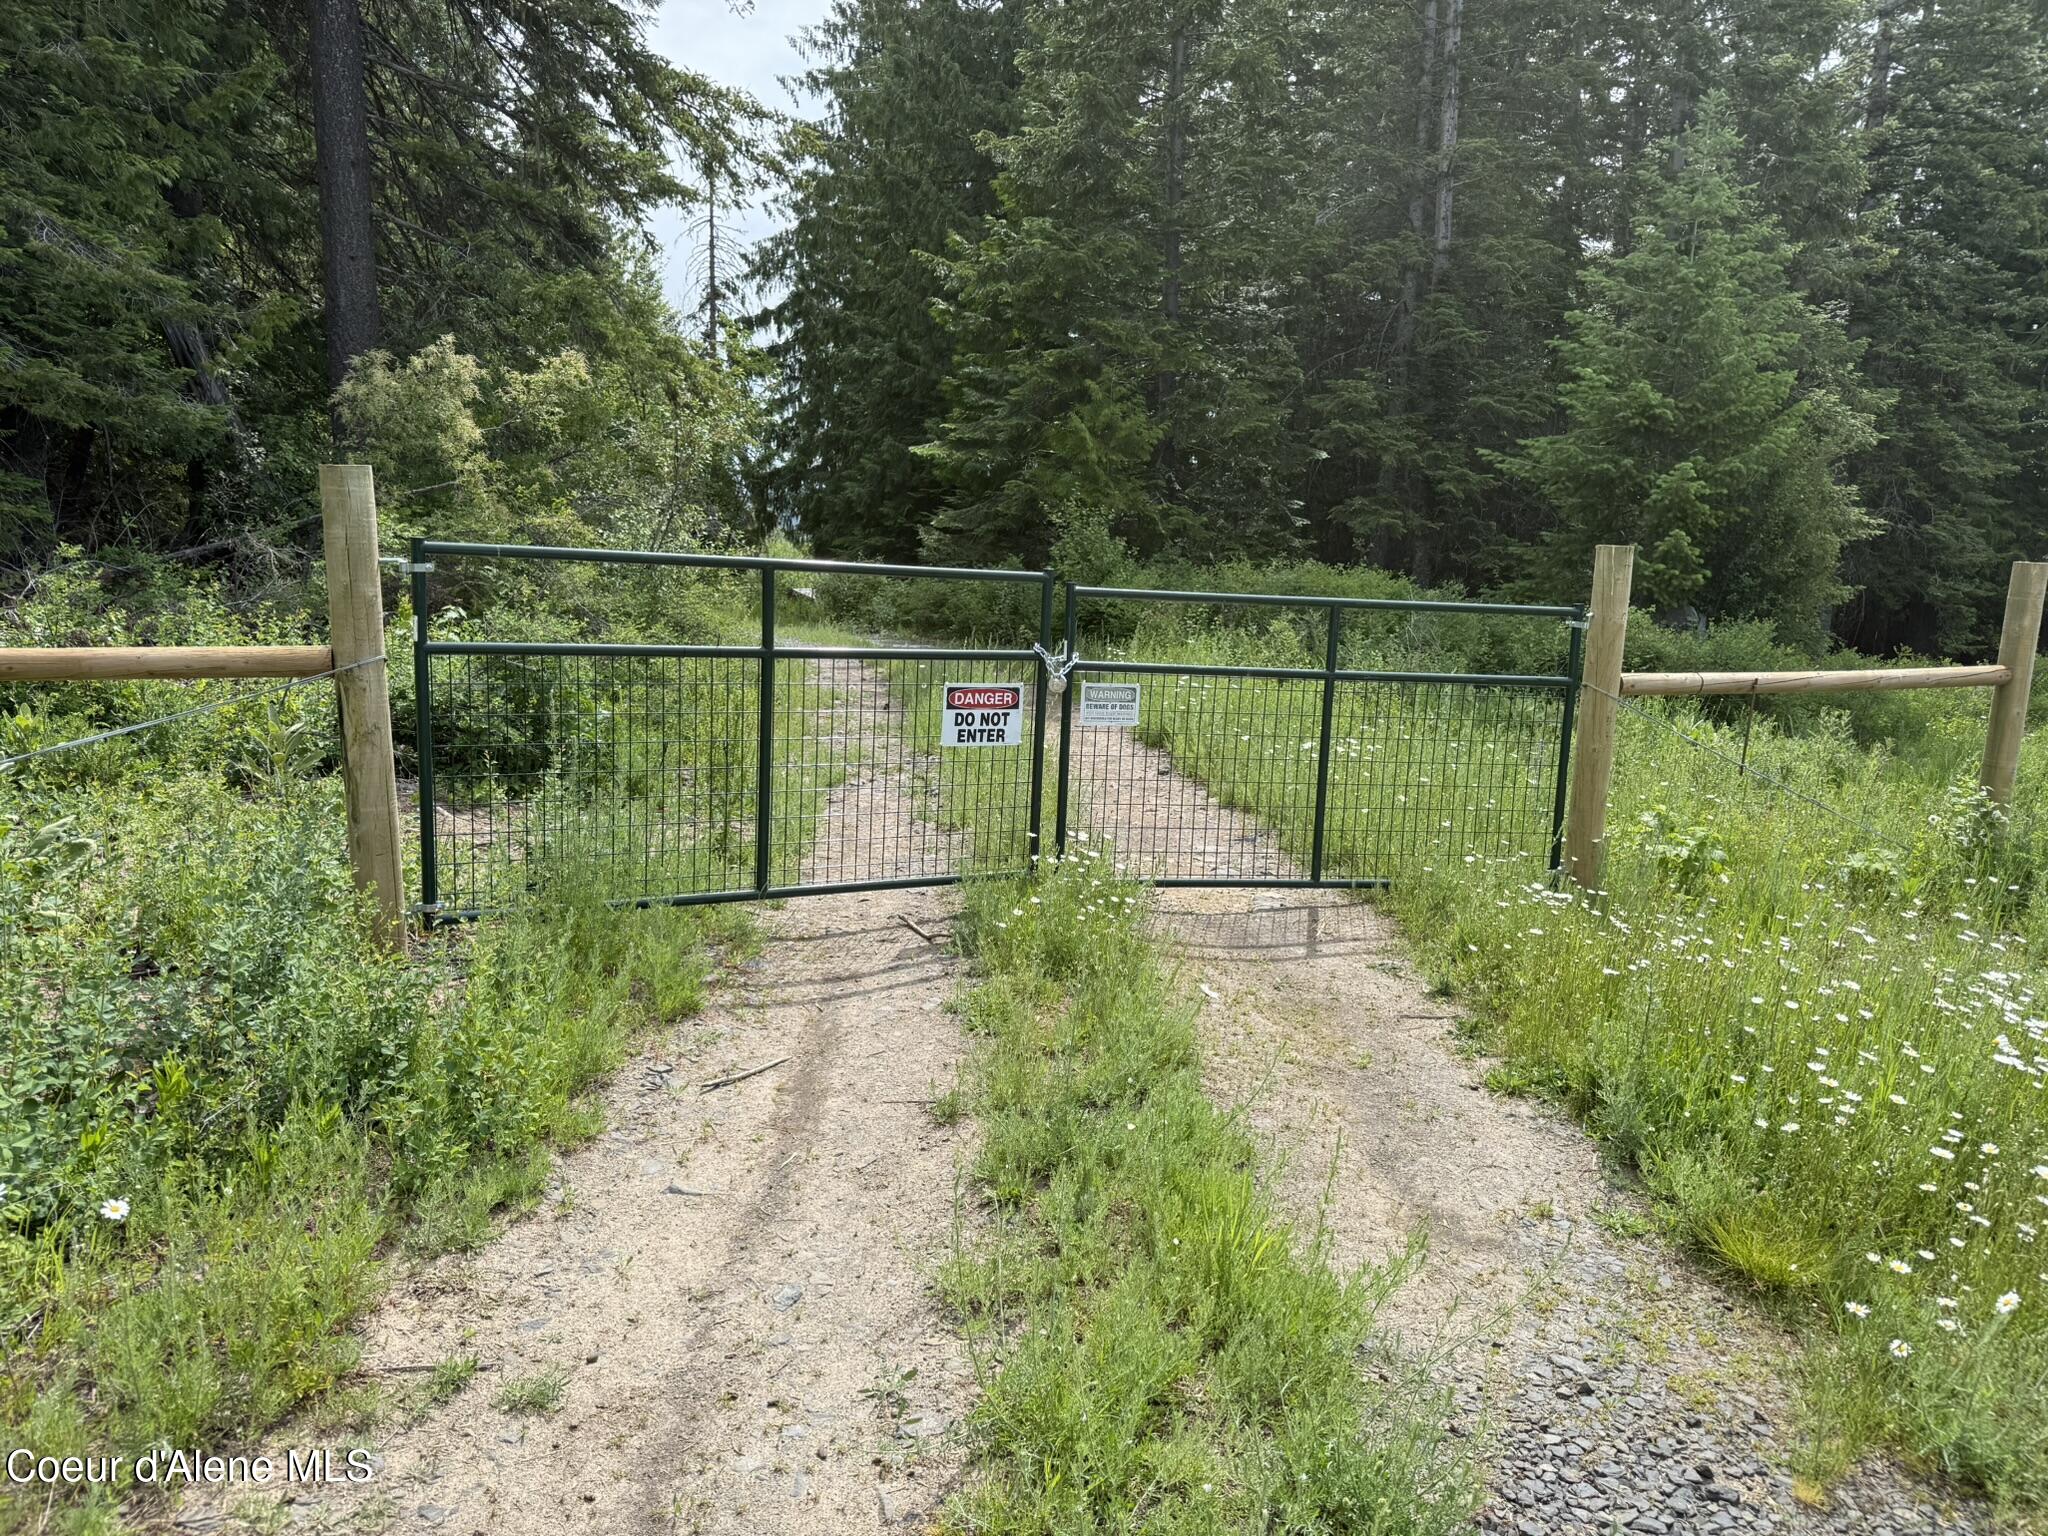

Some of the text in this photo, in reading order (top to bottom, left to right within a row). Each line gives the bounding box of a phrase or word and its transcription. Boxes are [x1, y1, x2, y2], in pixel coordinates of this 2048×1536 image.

[954, 693, 1012, 705] DANGER
[1090, 691, 1132, 700] WARNING
[954, 712, 1010, 726] DO NOT
[957, 729, 1005, 743] ENTER
